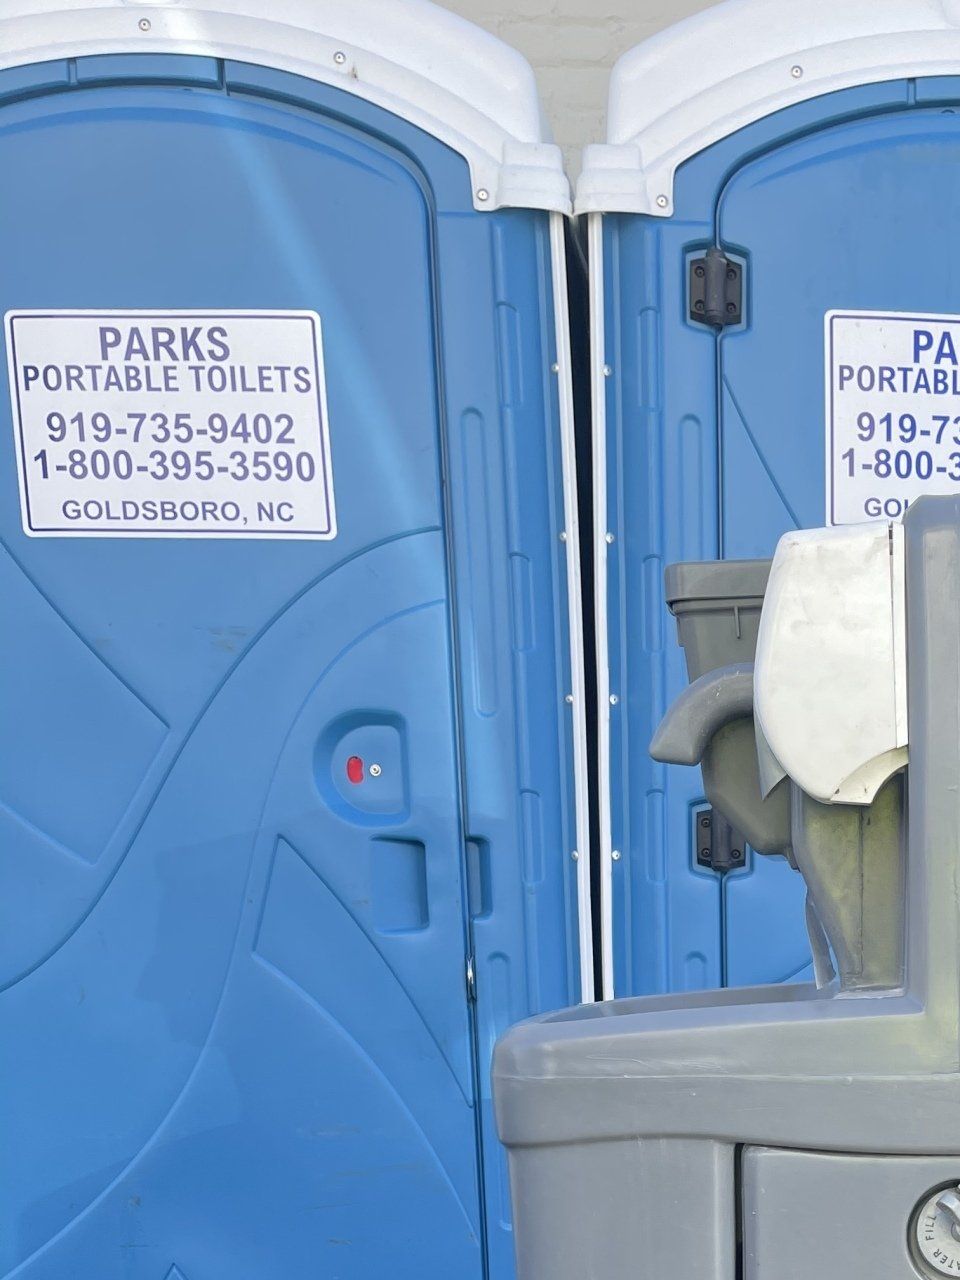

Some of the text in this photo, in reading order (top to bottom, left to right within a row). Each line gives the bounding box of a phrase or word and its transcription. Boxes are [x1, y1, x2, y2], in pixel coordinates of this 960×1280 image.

[99, 326, 230, 361] PARKS
[23, 365, 312, 393] PORTABLE TOILETS
[46, 412, 295, 444] 919-735-9402
[33, 449, 316, 482] 1-800-395-3590
[62, 500, 295, 525] GOLDSBORO, NC
[925, 1215, 937, 1241] FILL
